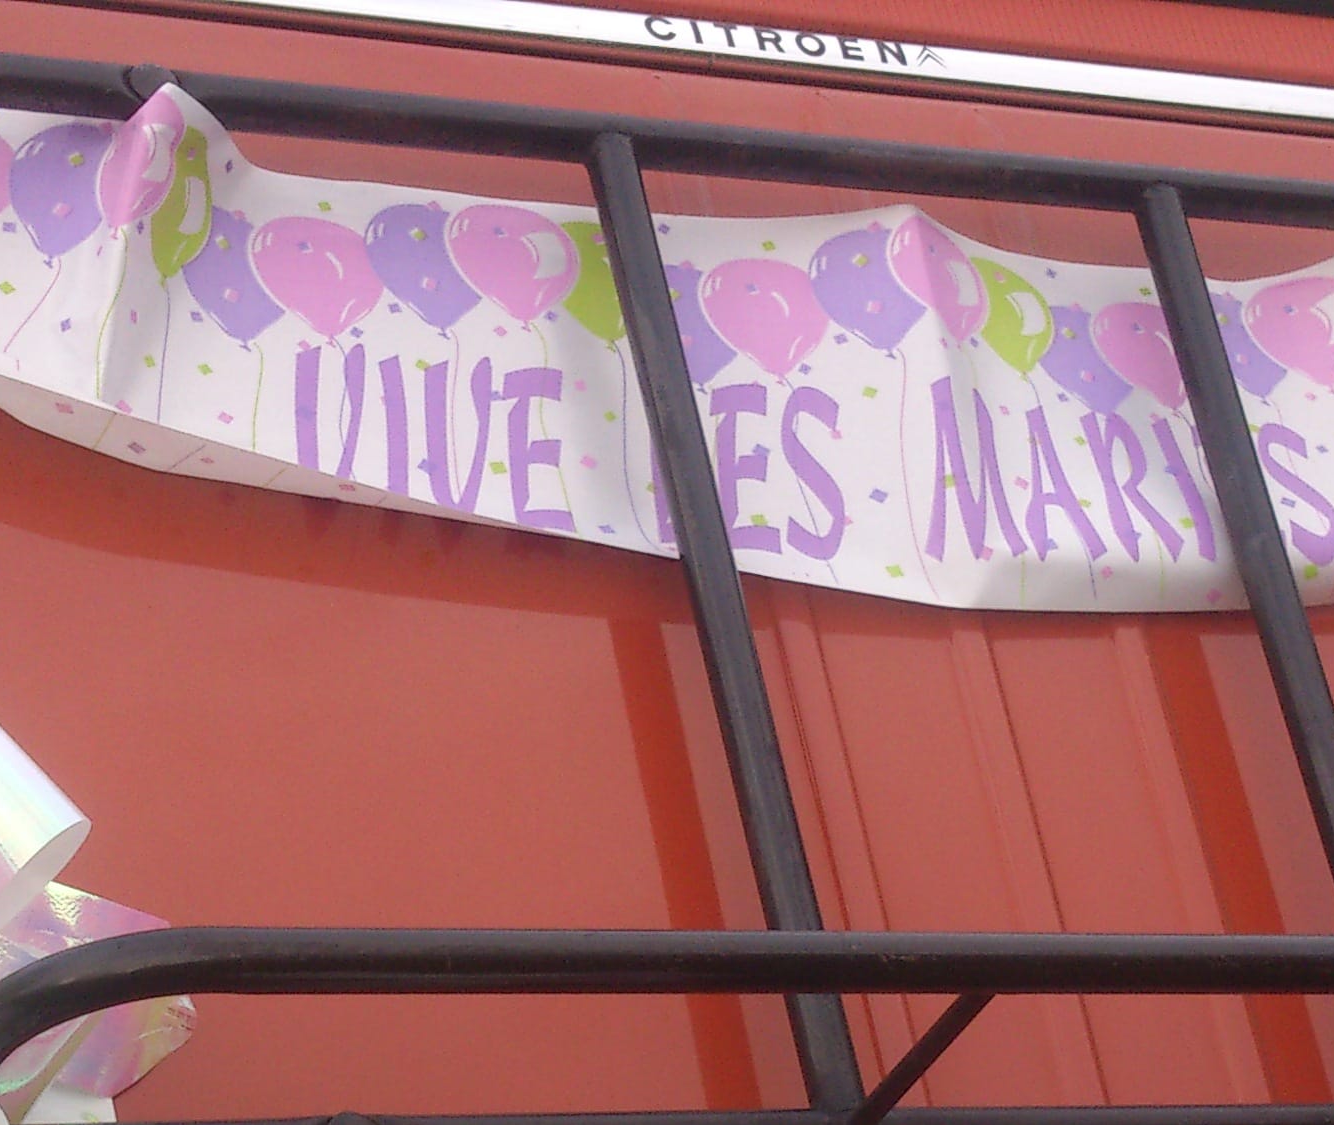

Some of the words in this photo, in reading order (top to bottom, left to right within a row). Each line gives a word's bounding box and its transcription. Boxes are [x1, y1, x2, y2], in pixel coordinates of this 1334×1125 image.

[643, 15, 908, 67] CITROEN
[295, 344, 574, 529] VIVE
[652, 383, 846, 560] ES
